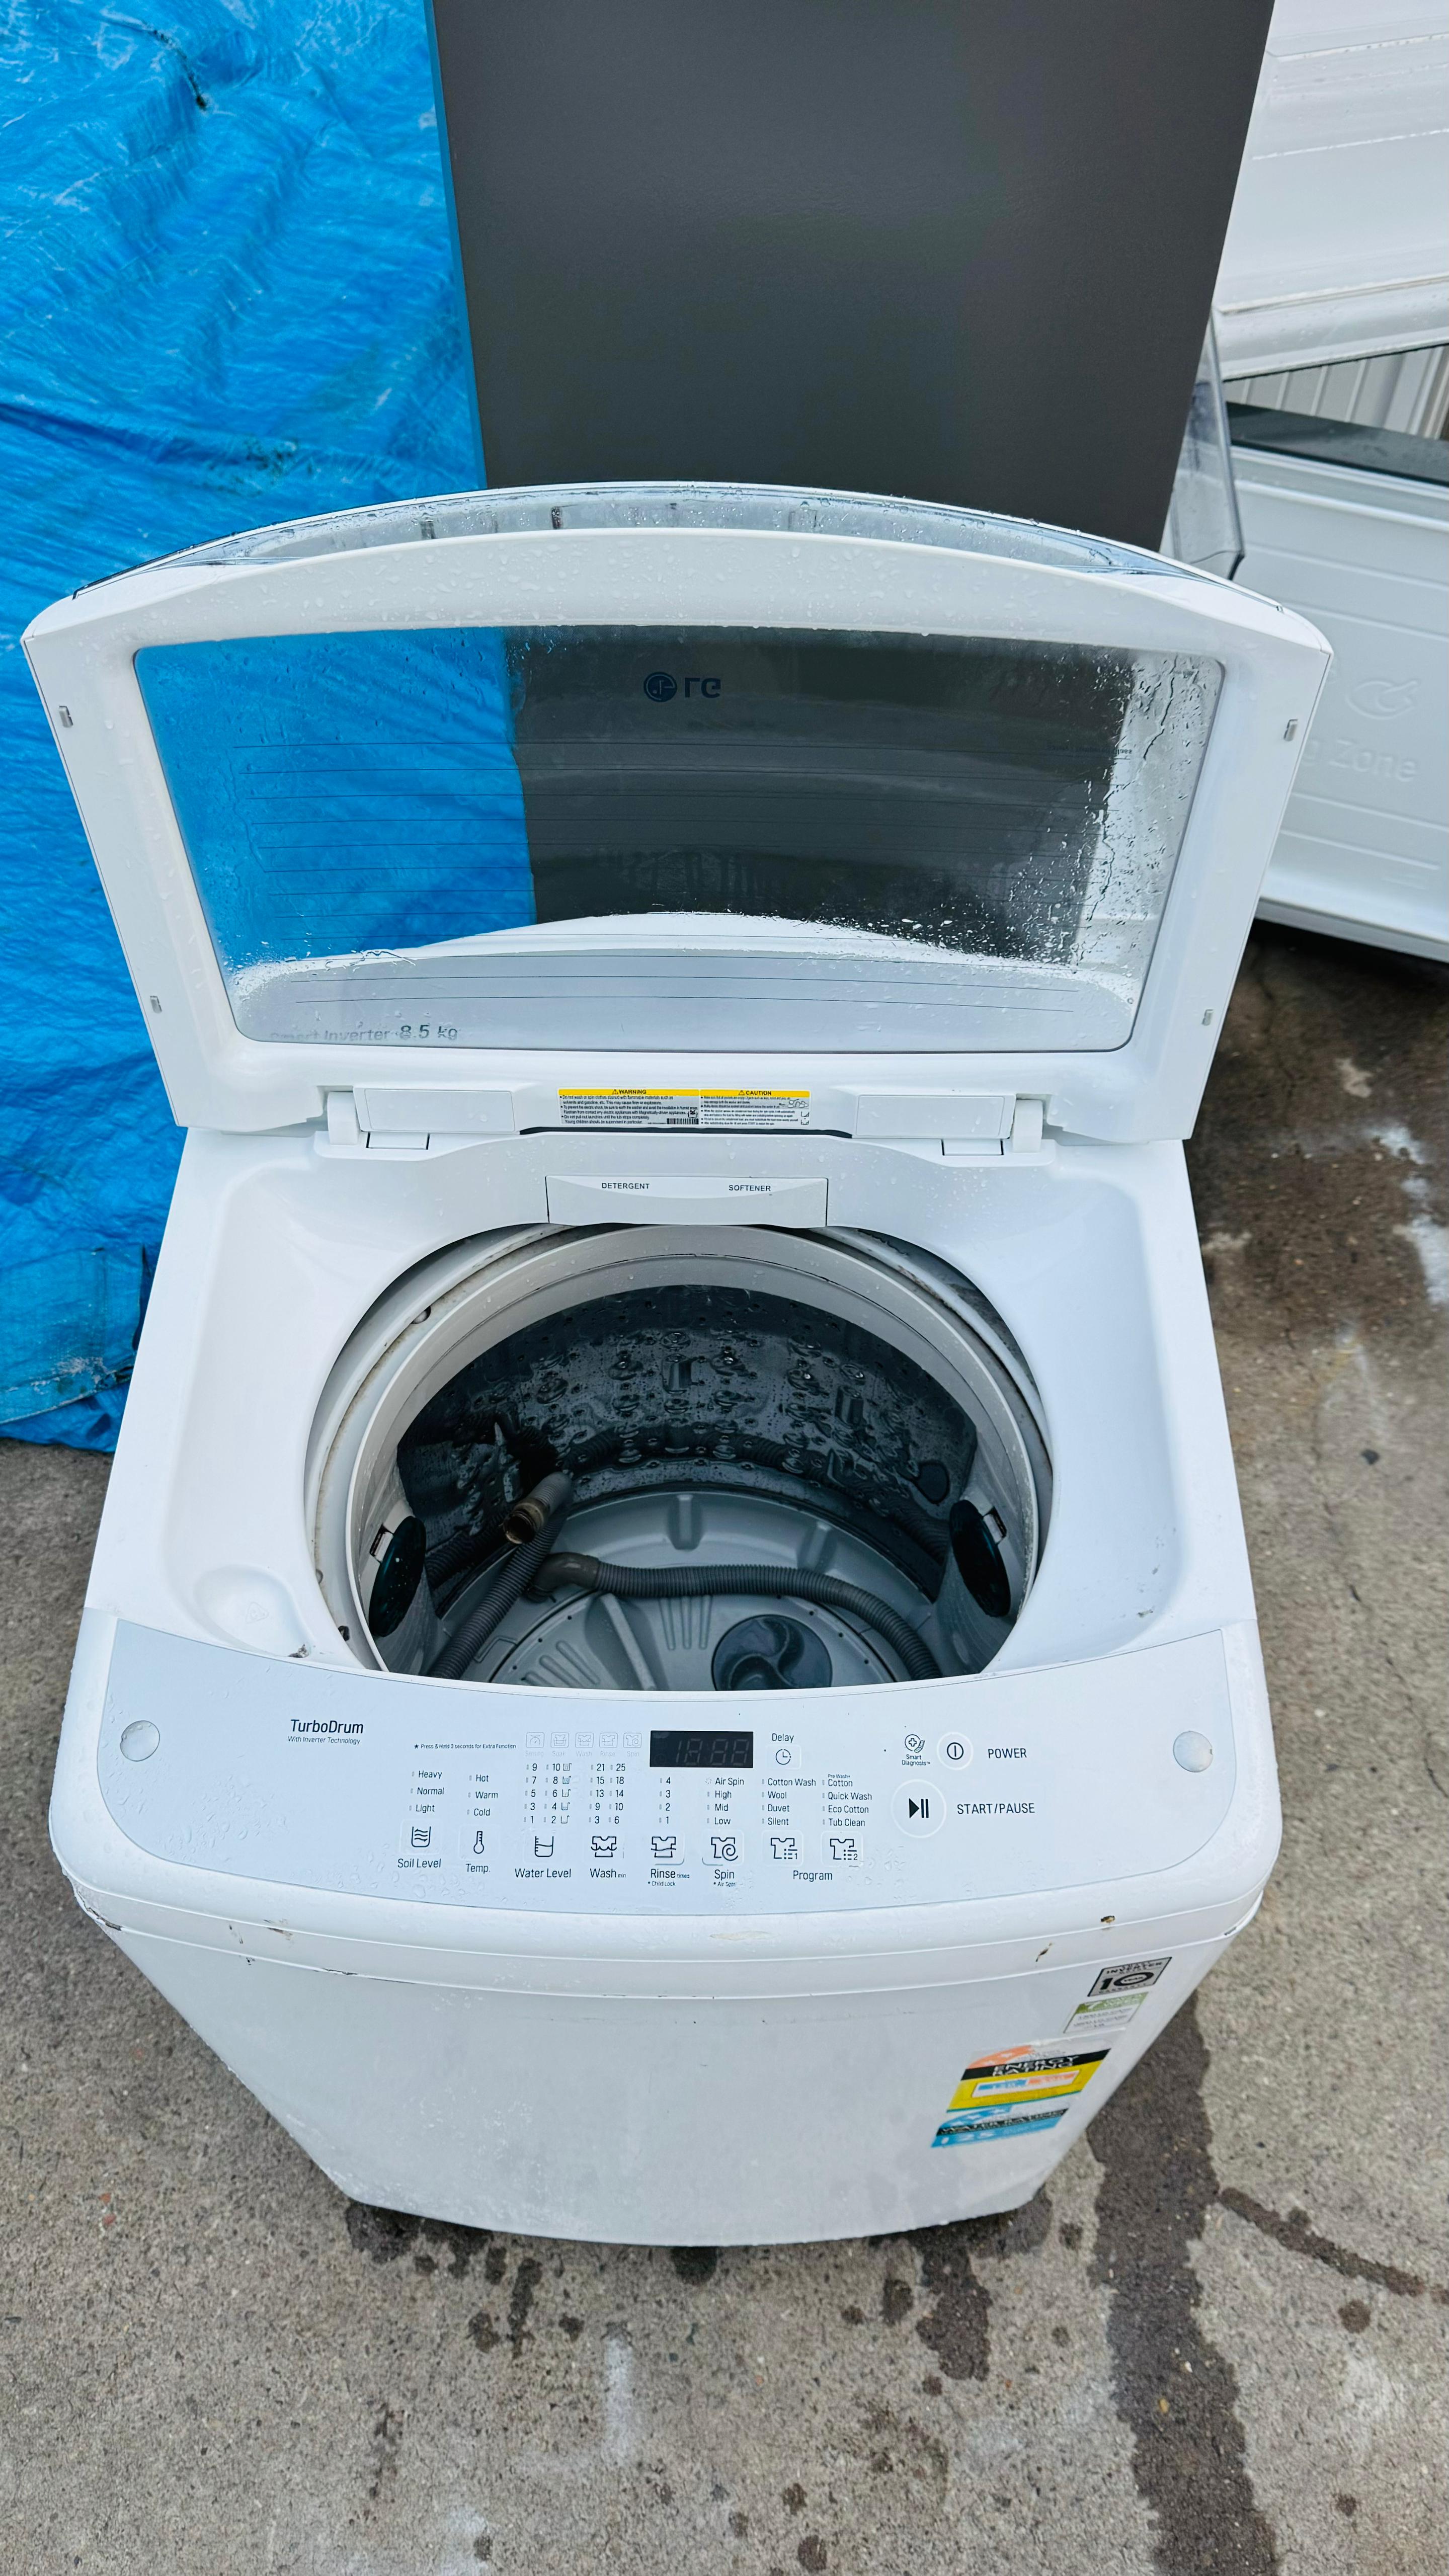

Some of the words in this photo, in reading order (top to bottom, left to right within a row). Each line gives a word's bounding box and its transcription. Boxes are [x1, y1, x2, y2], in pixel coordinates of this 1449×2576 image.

[1327, 737, 1418, 783] Zone
[437, 1026, 458, 1040] kg
[290, 1719, 364, 1734] TurboDrum
[328, 1737, 360, 1745] Technology
[772, 1733, 794, 1743] Delay
[988, 1748, 1027, 1759] POWER
[532, 1763, 537, 1772] 9
[552, 1763, 560, 1772] 10
[597, 1763, 604, 1772] 21
[616, 1763, 626, 1772] 25
[418, 1770, 443, 1780] Heavy
[475, 1774, 489, 1782] Hot
[532, 1776, 537, 1784] 7
[552, 1776, 558, 1785] 8
[596, 1776, 605, 1785] 15
[616, 1776, 624, 1785] 18
[715, 1777, 727, 1785] Air
[728, 1777, 744, 1787] Spin
[768, 1778, 793, 1786] Cotton
[794, 1778, 816, 1787] Wash
[828, 1779, 853, 1787] Cotton
[475, 1791, 498, 1799] Warm
[531, 1789, 536, 1798] 5
[552, 1789, 557, 1798] 6
[596, 1789, 604, 1798] 13
[615, 1790, 624, 1798] 14
[666, 1790, 671, 1798] 3
[715, 1790, 732, 1800] High
[767, 1791, 787, 1799] Wool
[828, 1792, 849, 1800] Quick
[850, 1792, 872, 1800] Wash
[416, 1804, 435, 1814] Light
[530, 1802, 535, 1811] 3
[551, 1802, 556, 1810] 4
[595, 1802, 600, 1811] 9
[615, 1802, 623, 1811] 10
[665, 1803, 670, 1811] 2
[715, 1803, 729, 1811] Mid
[768, 1804, 789, 1812] Duvet
[828, 1805, 842, 1813] Eco
[844, 1805, 869, 1813] Cotton
[957, 1803, 1035, 1815] START/PAUSE
[473, 1808, 491, 1816] Cold
[530, 1815, 534, 1824] 1
[551, 1815, 556, 1824] 2
[595, 1815, 600, 1824] 3
[614, 1816, 619, 1824] 6
[666, 1816, 669, 1824] 1
[714, 1817, 731, 1825] Low
[767, 1817, 789, 1826] Silent
[828, 1818, 843, 1826] Tub
[844, 1818, 865, 1827] Clean
[397, 1858, 415, 1868] Soil
[417, 1858, 441, 1868] Level
[465, 1863, 490, 1874] Temp.
[515, 1868, 544, 1878] Water
[546, 1868, 571, 1878] Level
[590, 1868, 616, 1878] Wash
[651, 1868, 676, 1879] Rinse
[714, 1869, 735, 1881] Spin
[793, 1870, 833, 1882] Program
